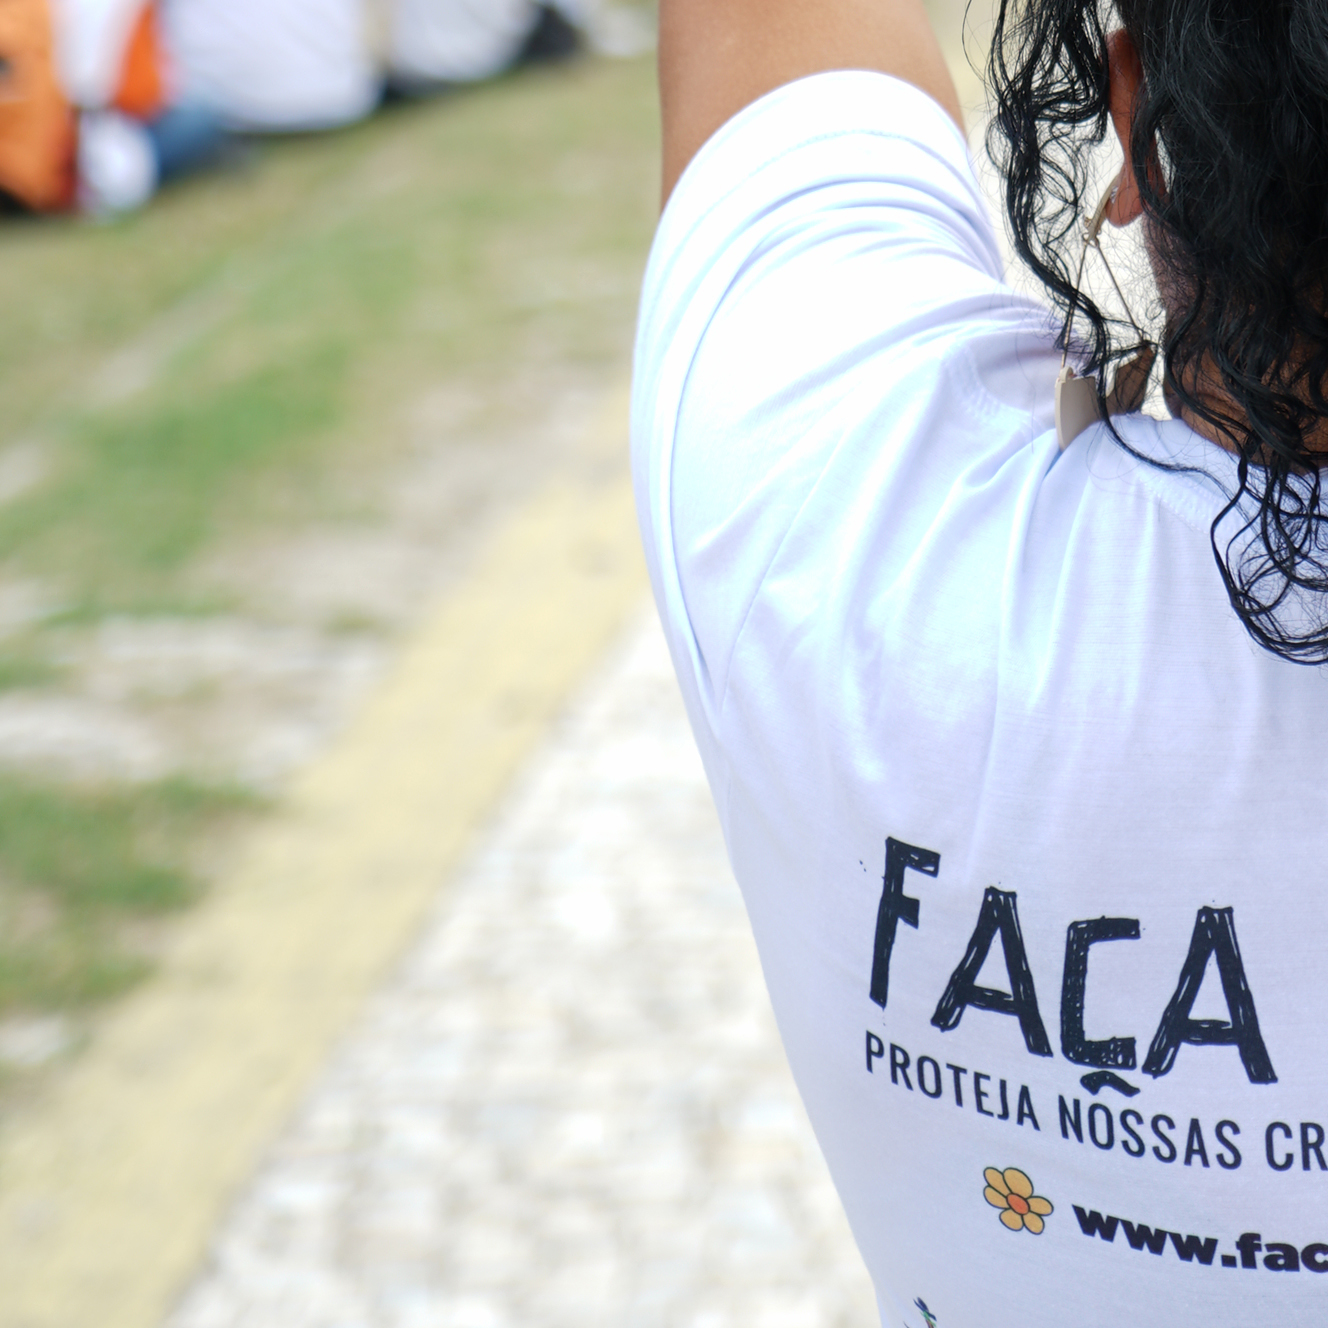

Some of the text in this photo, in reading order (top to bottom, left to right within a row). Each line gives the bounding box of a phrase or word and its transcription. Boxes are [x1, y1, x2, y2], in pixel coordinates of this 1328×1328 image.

[867, 835, 1279, 1099] FAÇA
[865, 1030, 1041, 1132] PROTEJA
[1058, 1093, 1242, 1171] NOSSAS
